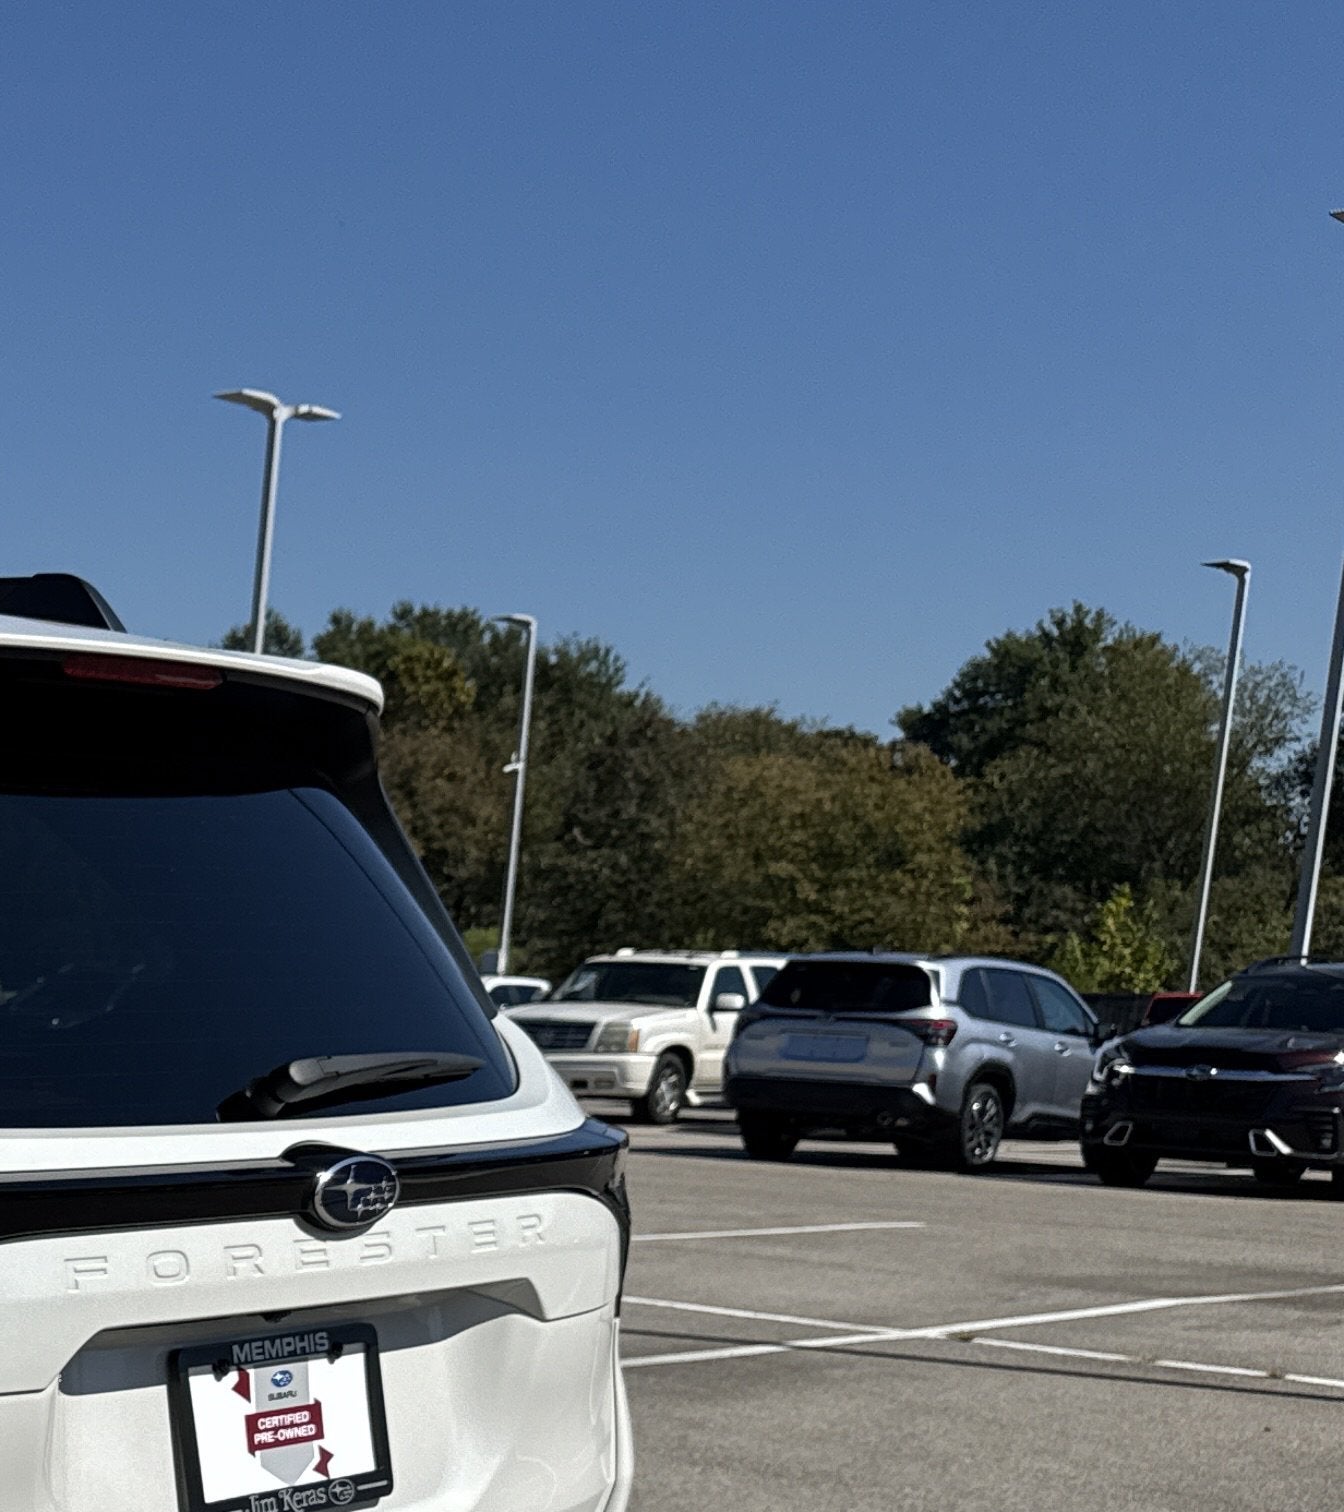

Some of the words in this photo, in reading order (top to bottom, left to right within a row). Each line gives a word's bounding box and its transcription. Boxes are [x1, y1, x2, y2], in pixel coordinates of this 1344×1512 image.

[64, 1213, 546, 1294] FORESTER
[232, 1332, 329, 1364] MEMPHIS
[267, 1390, 298, 1402] SUBARU
[257, 1411, 311, 1430] CERTIFIED
[254, 1424, 316, 1445] PRE-OWNED
